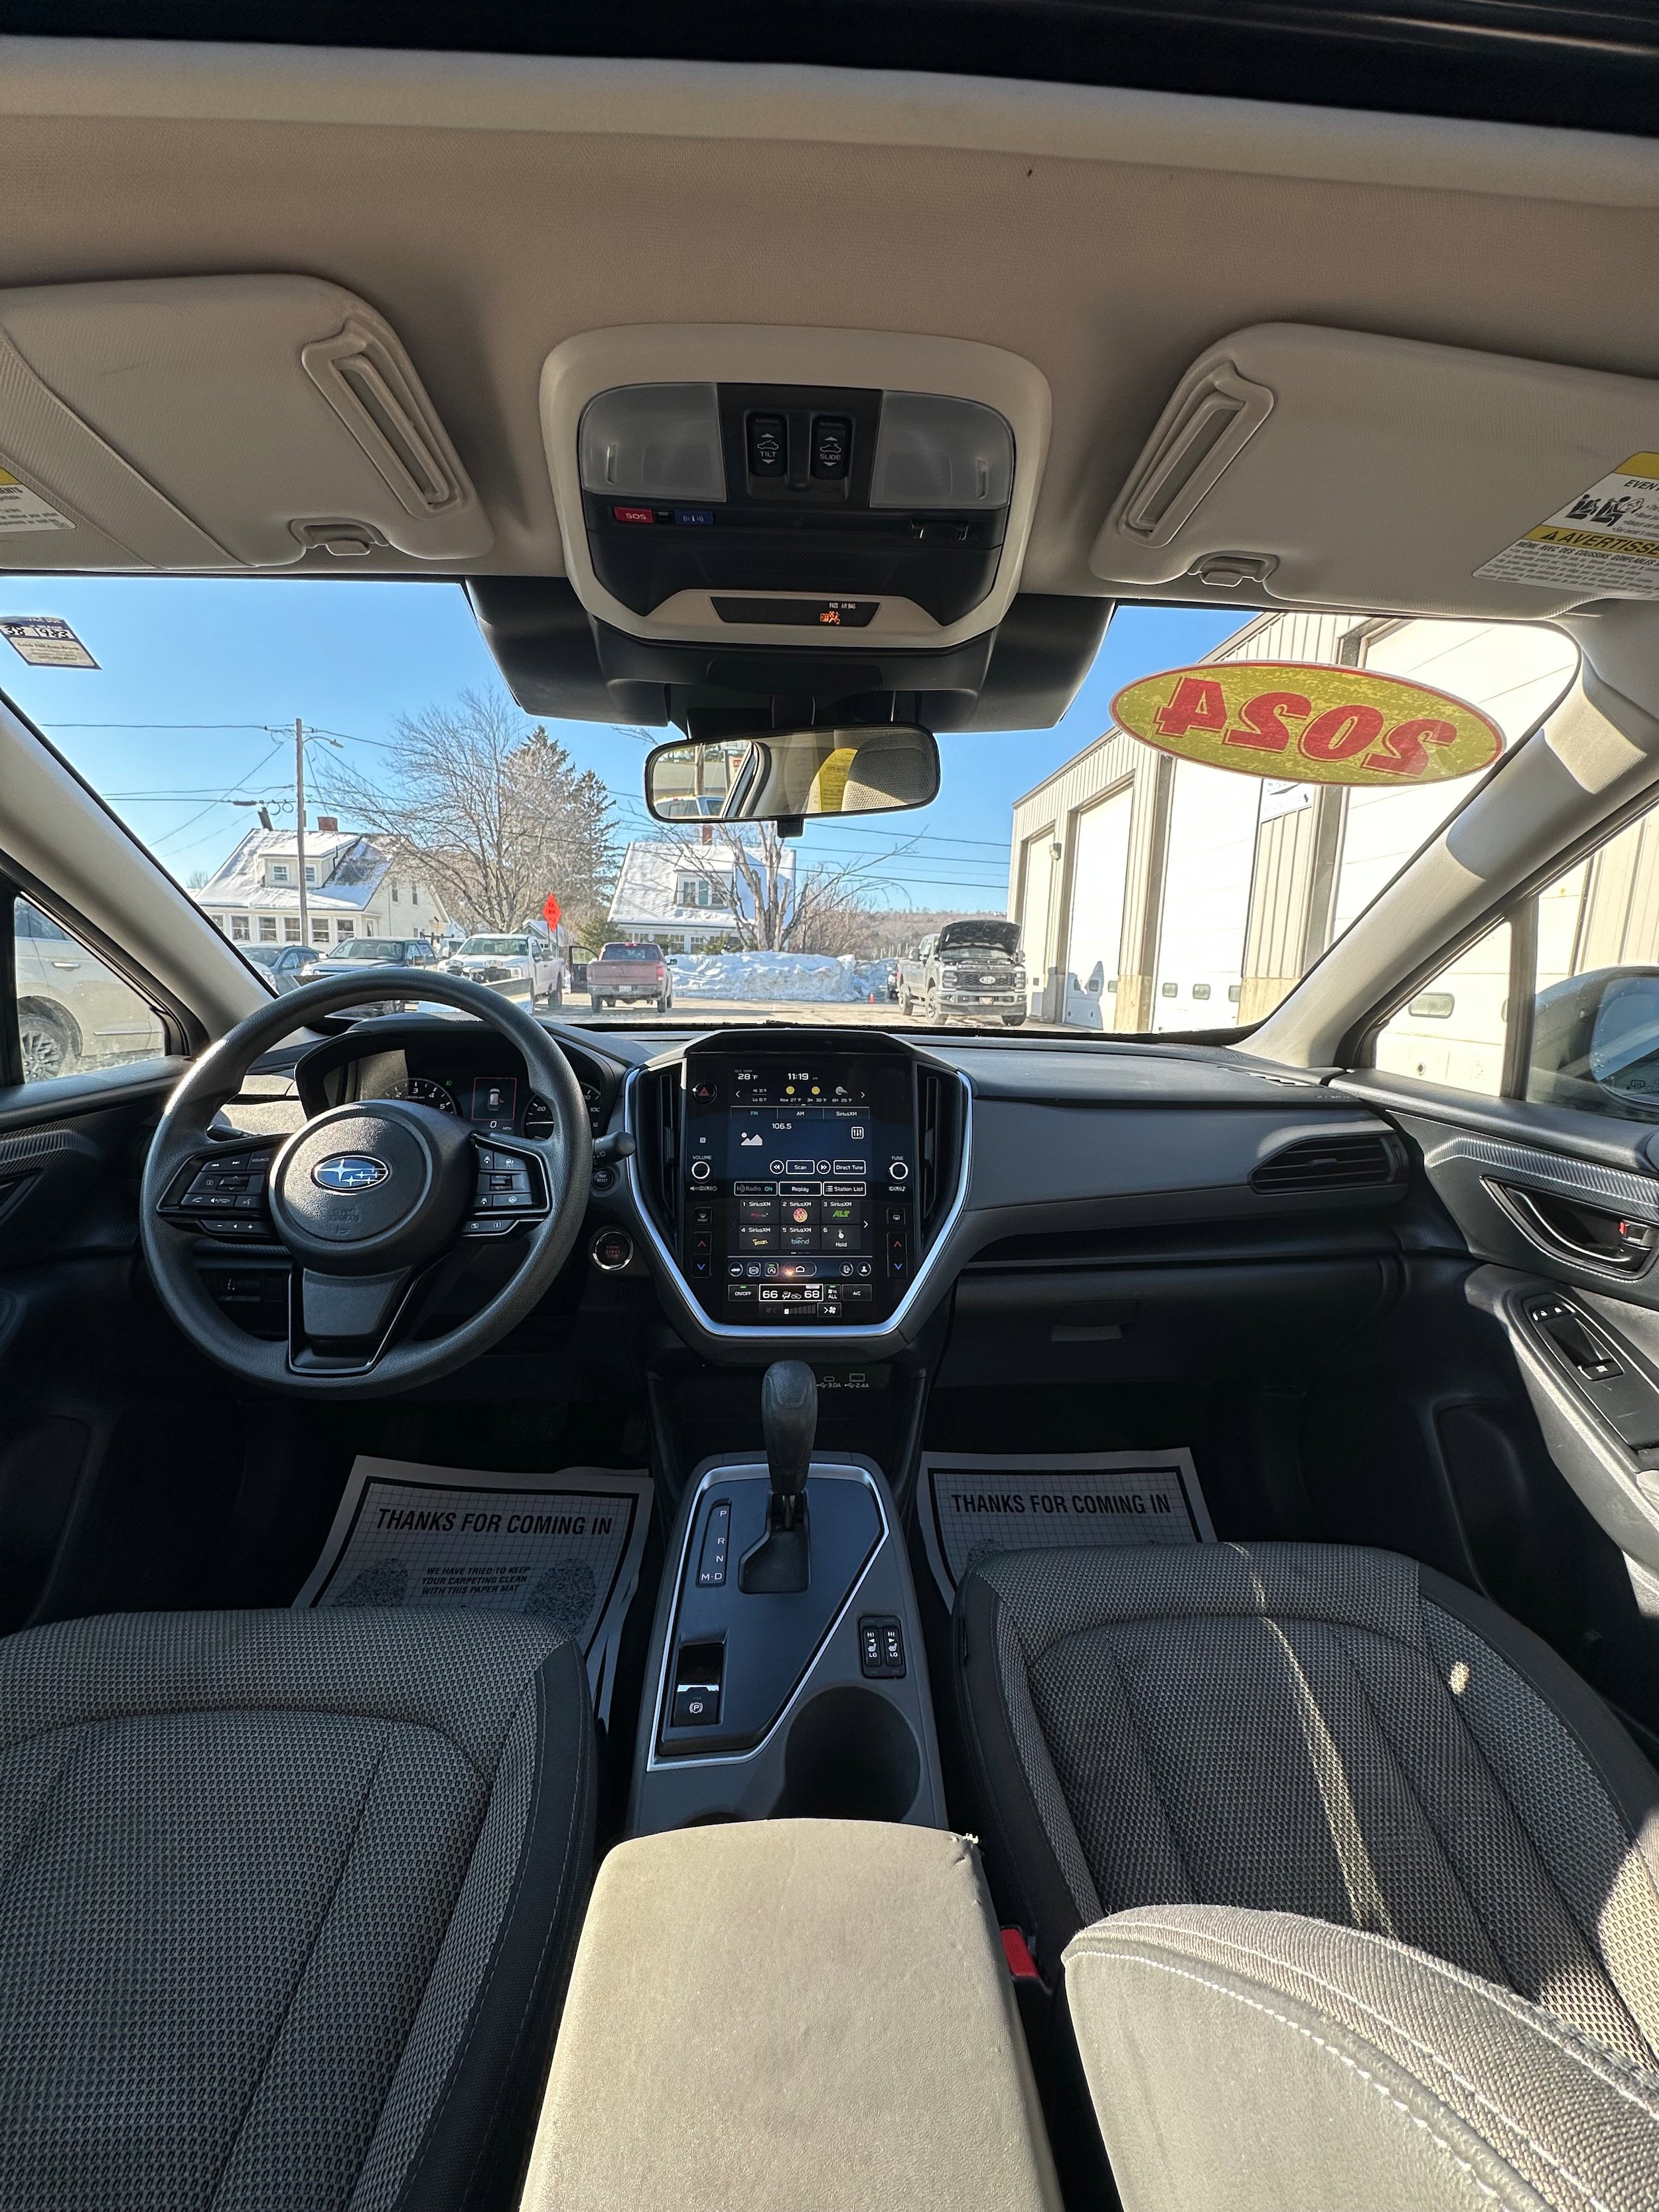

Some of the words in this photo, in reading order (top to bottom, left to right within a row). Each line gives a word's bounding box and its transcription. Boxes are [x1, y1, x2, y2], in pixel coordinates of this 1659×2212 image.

[1623, 479, 1658, 490] EVEN
[39, 628, 69, 638] 983
[762, 1290, 778, 1299] 66
[804, 1290, 820, 1299] 68
[951, 1494, 1026, 1513] THANKS
[1030, 1494, 1068, 1513] FOR
[1071, 1494, 1146, 1514] COMING
[1149, 1493, 1171, 1513] IN
[376, 1508, 457, 1532] THANKS
[461, 1512, 502, 1532] FOR
[507, 1514, 586, 1535] COMING
[591, 1517, 613, 1535] IN
[448, 1576, 498, 1585] CARPETING
